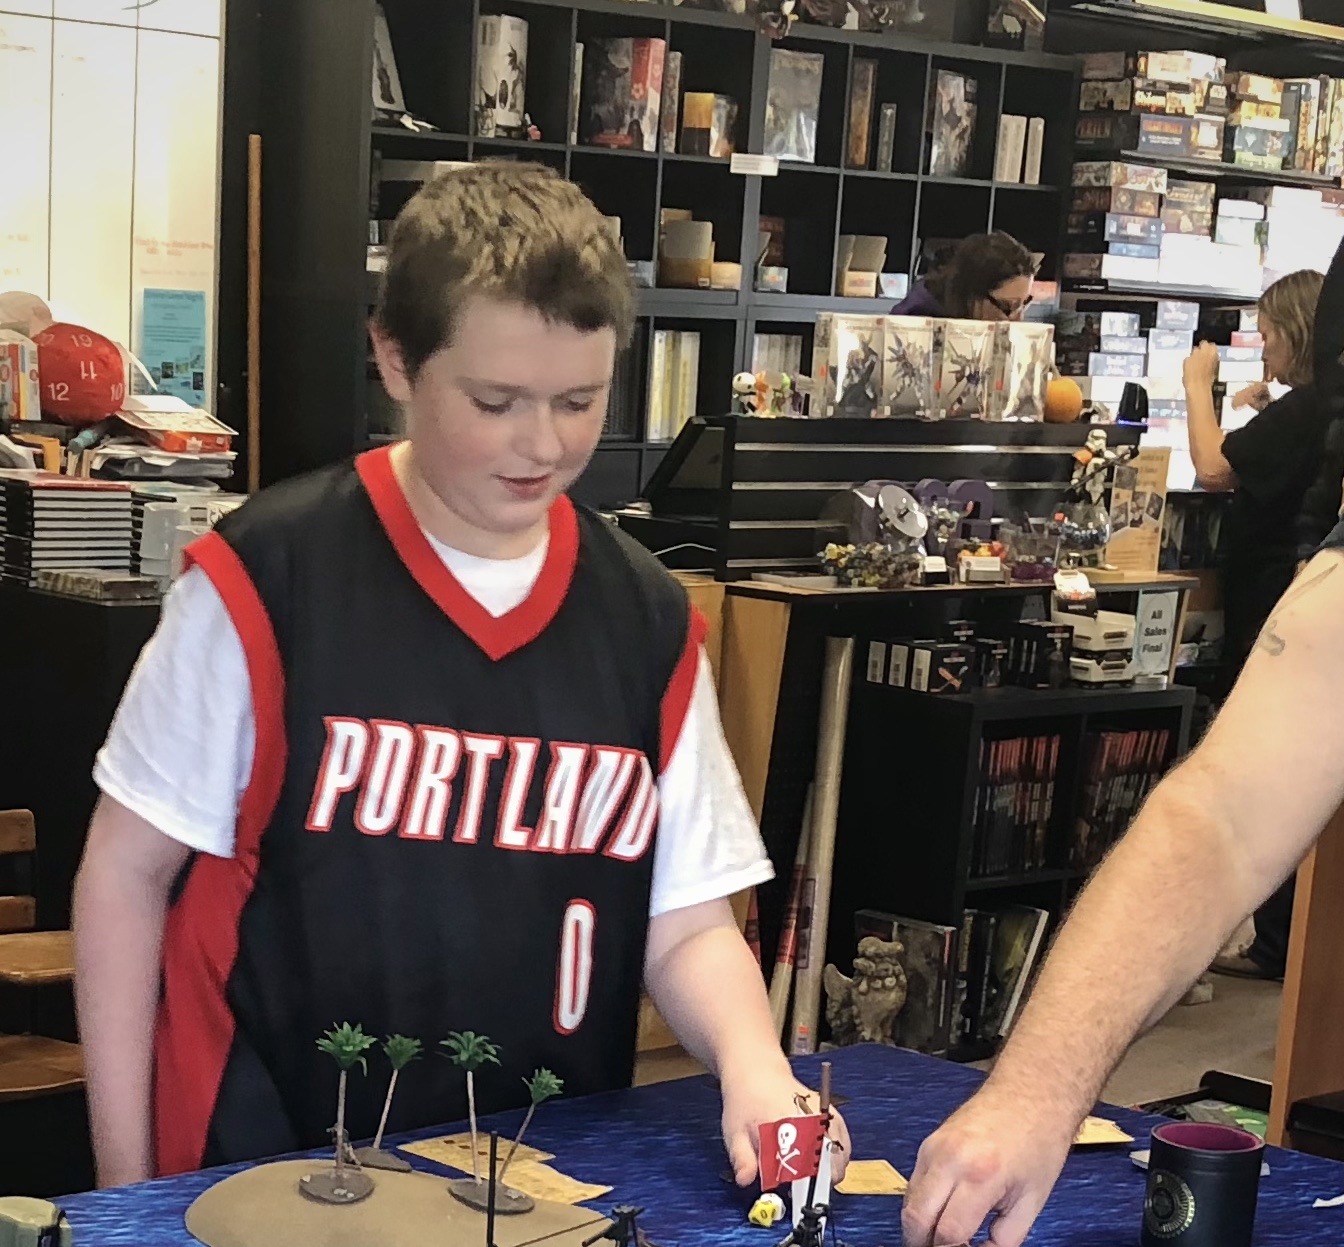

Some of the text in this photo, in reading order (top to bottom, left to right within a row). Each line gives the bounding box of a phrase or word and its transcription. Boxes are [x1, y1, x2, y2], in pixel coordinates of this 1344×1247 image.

[70, 334, 93, 348] 19
[47, 382, 70, 401] 12
[1143, 626, 1168, 638] Sales
[305, 715, 658, 862] PORTLAND
[552, 898, 596, 1035] 0
